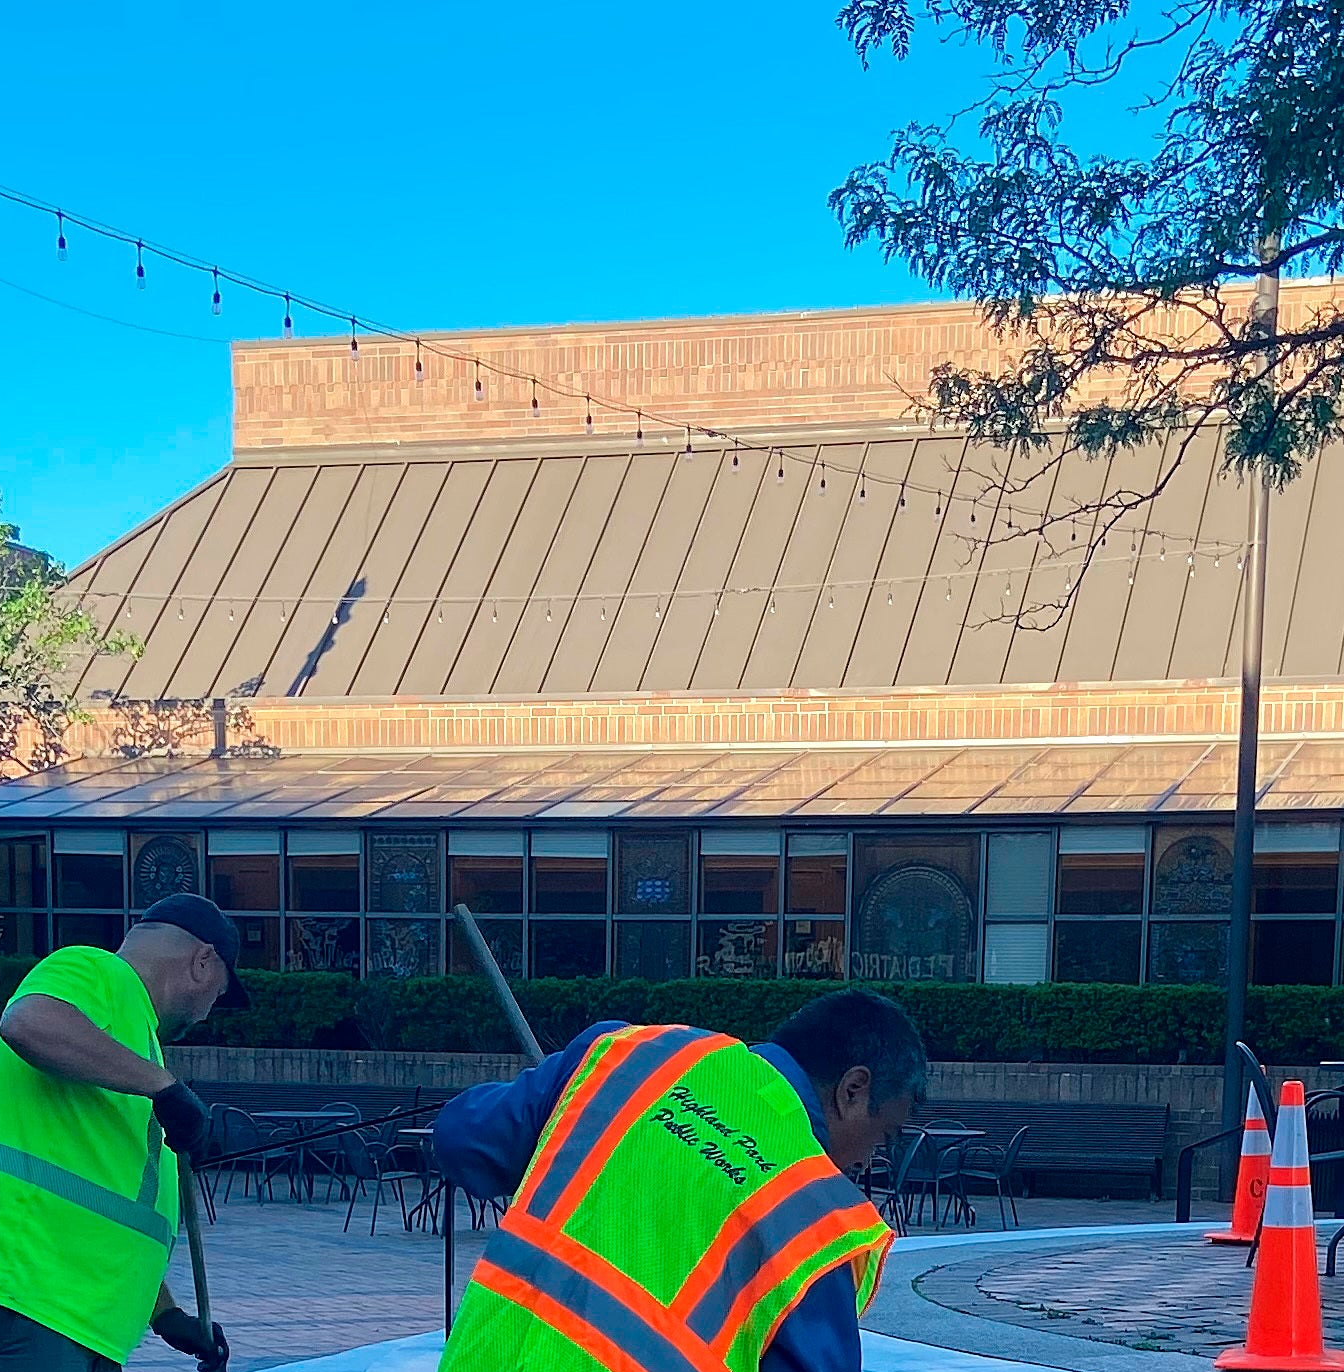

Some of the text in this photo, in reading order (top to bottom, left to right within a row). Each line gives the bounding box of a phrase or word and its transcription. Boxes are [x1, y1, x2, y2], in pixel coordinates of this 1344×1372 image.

[649, 1108, 746, 1185] Public Works
[668, 1086, 777, 1173] Highland Park
